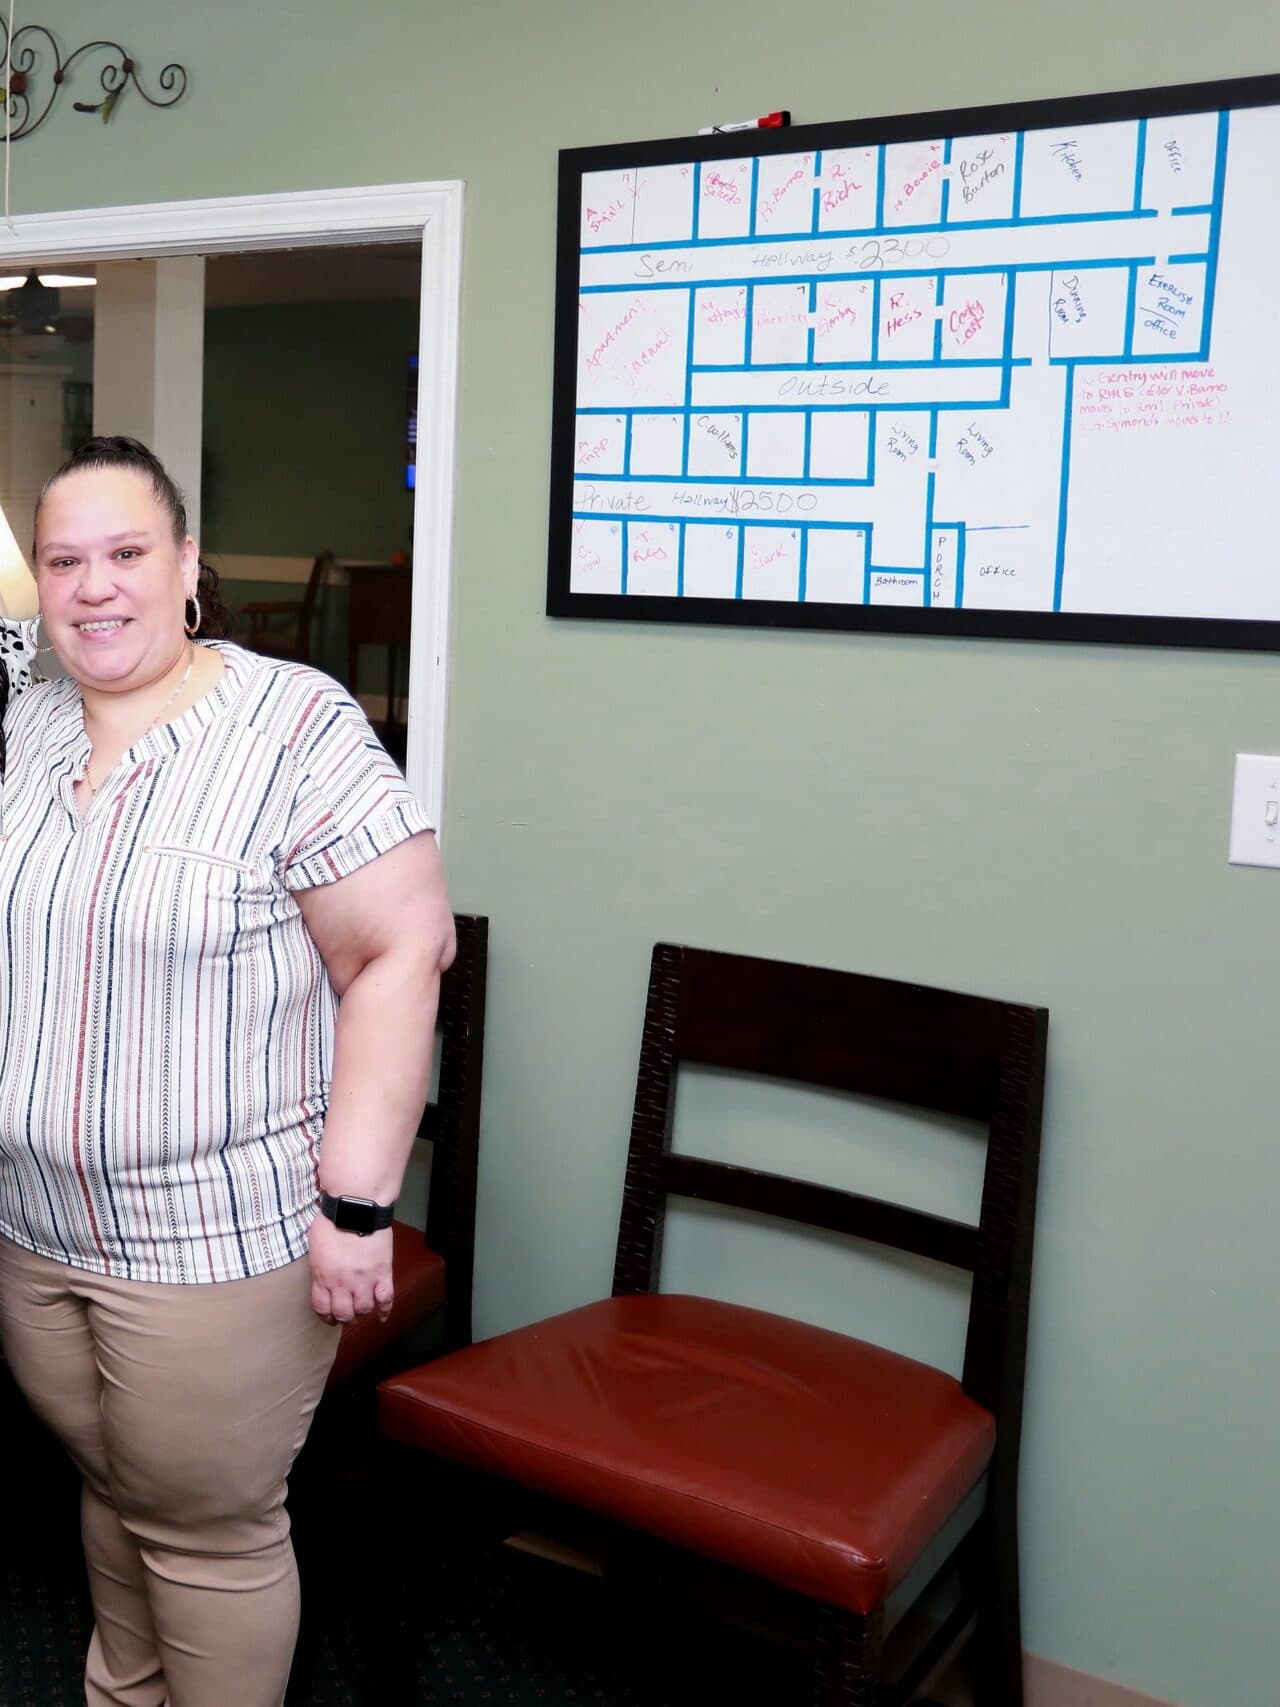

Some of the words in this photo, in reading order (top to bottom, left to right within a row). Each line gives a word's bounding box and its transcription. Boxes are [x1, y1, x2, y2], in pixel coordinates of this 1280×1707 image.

[960, 148, 994, 184] Rose
[1049, 140, 1083, 182] Kitchen
[821, 180, 863, 213] Rich
[962, 163, 1005, 204] Burton
[634, 254, 693, 278] Semi
[724, 488, 818, 516] $2500
[725, 529, 734, 540] 6
